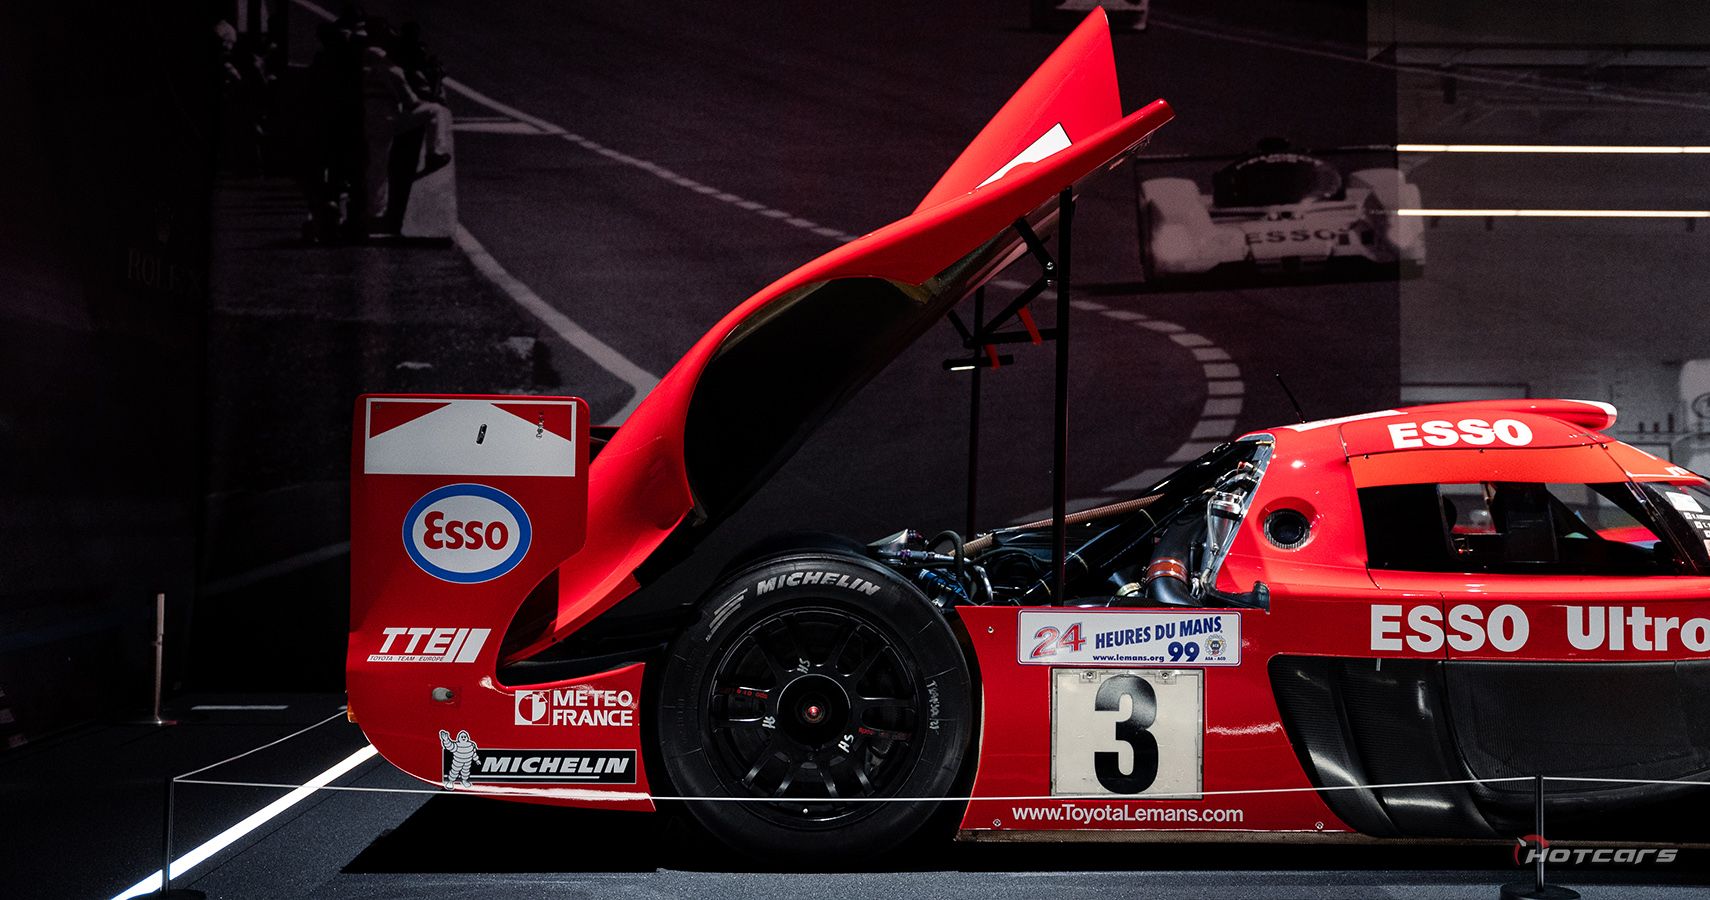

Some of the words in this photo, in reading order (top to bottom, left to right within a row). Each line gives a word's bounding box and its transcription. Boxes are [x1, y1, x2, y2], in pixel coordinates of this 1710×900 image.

[1245, 229, 1336, 245] ESSO
[1387, 418, 1533, 449] ESSO
[756, 571, 882, 596] MICHELIN
[1029, 621, 1088, 660] 24
[1095, 625, 1151, 650] HEURES
[1155, 622, 1176, 641] DU
[1179, 615, 1222, 637] MANS
[1370, 604, 1530, 653] ESSO
[1092, 653, 1165, 663] www.lemans.org
[1168, 641, 1200, 662] 99
[553, 690, 633, 706] METEO
[553, 710, 633, 726] FRANCE
[1094, 673, 1159, 795] 3
[481, 757, 630, 773] MICHELIN
[1012, 803, 1244, 823] www.ToyotaLemans.com
